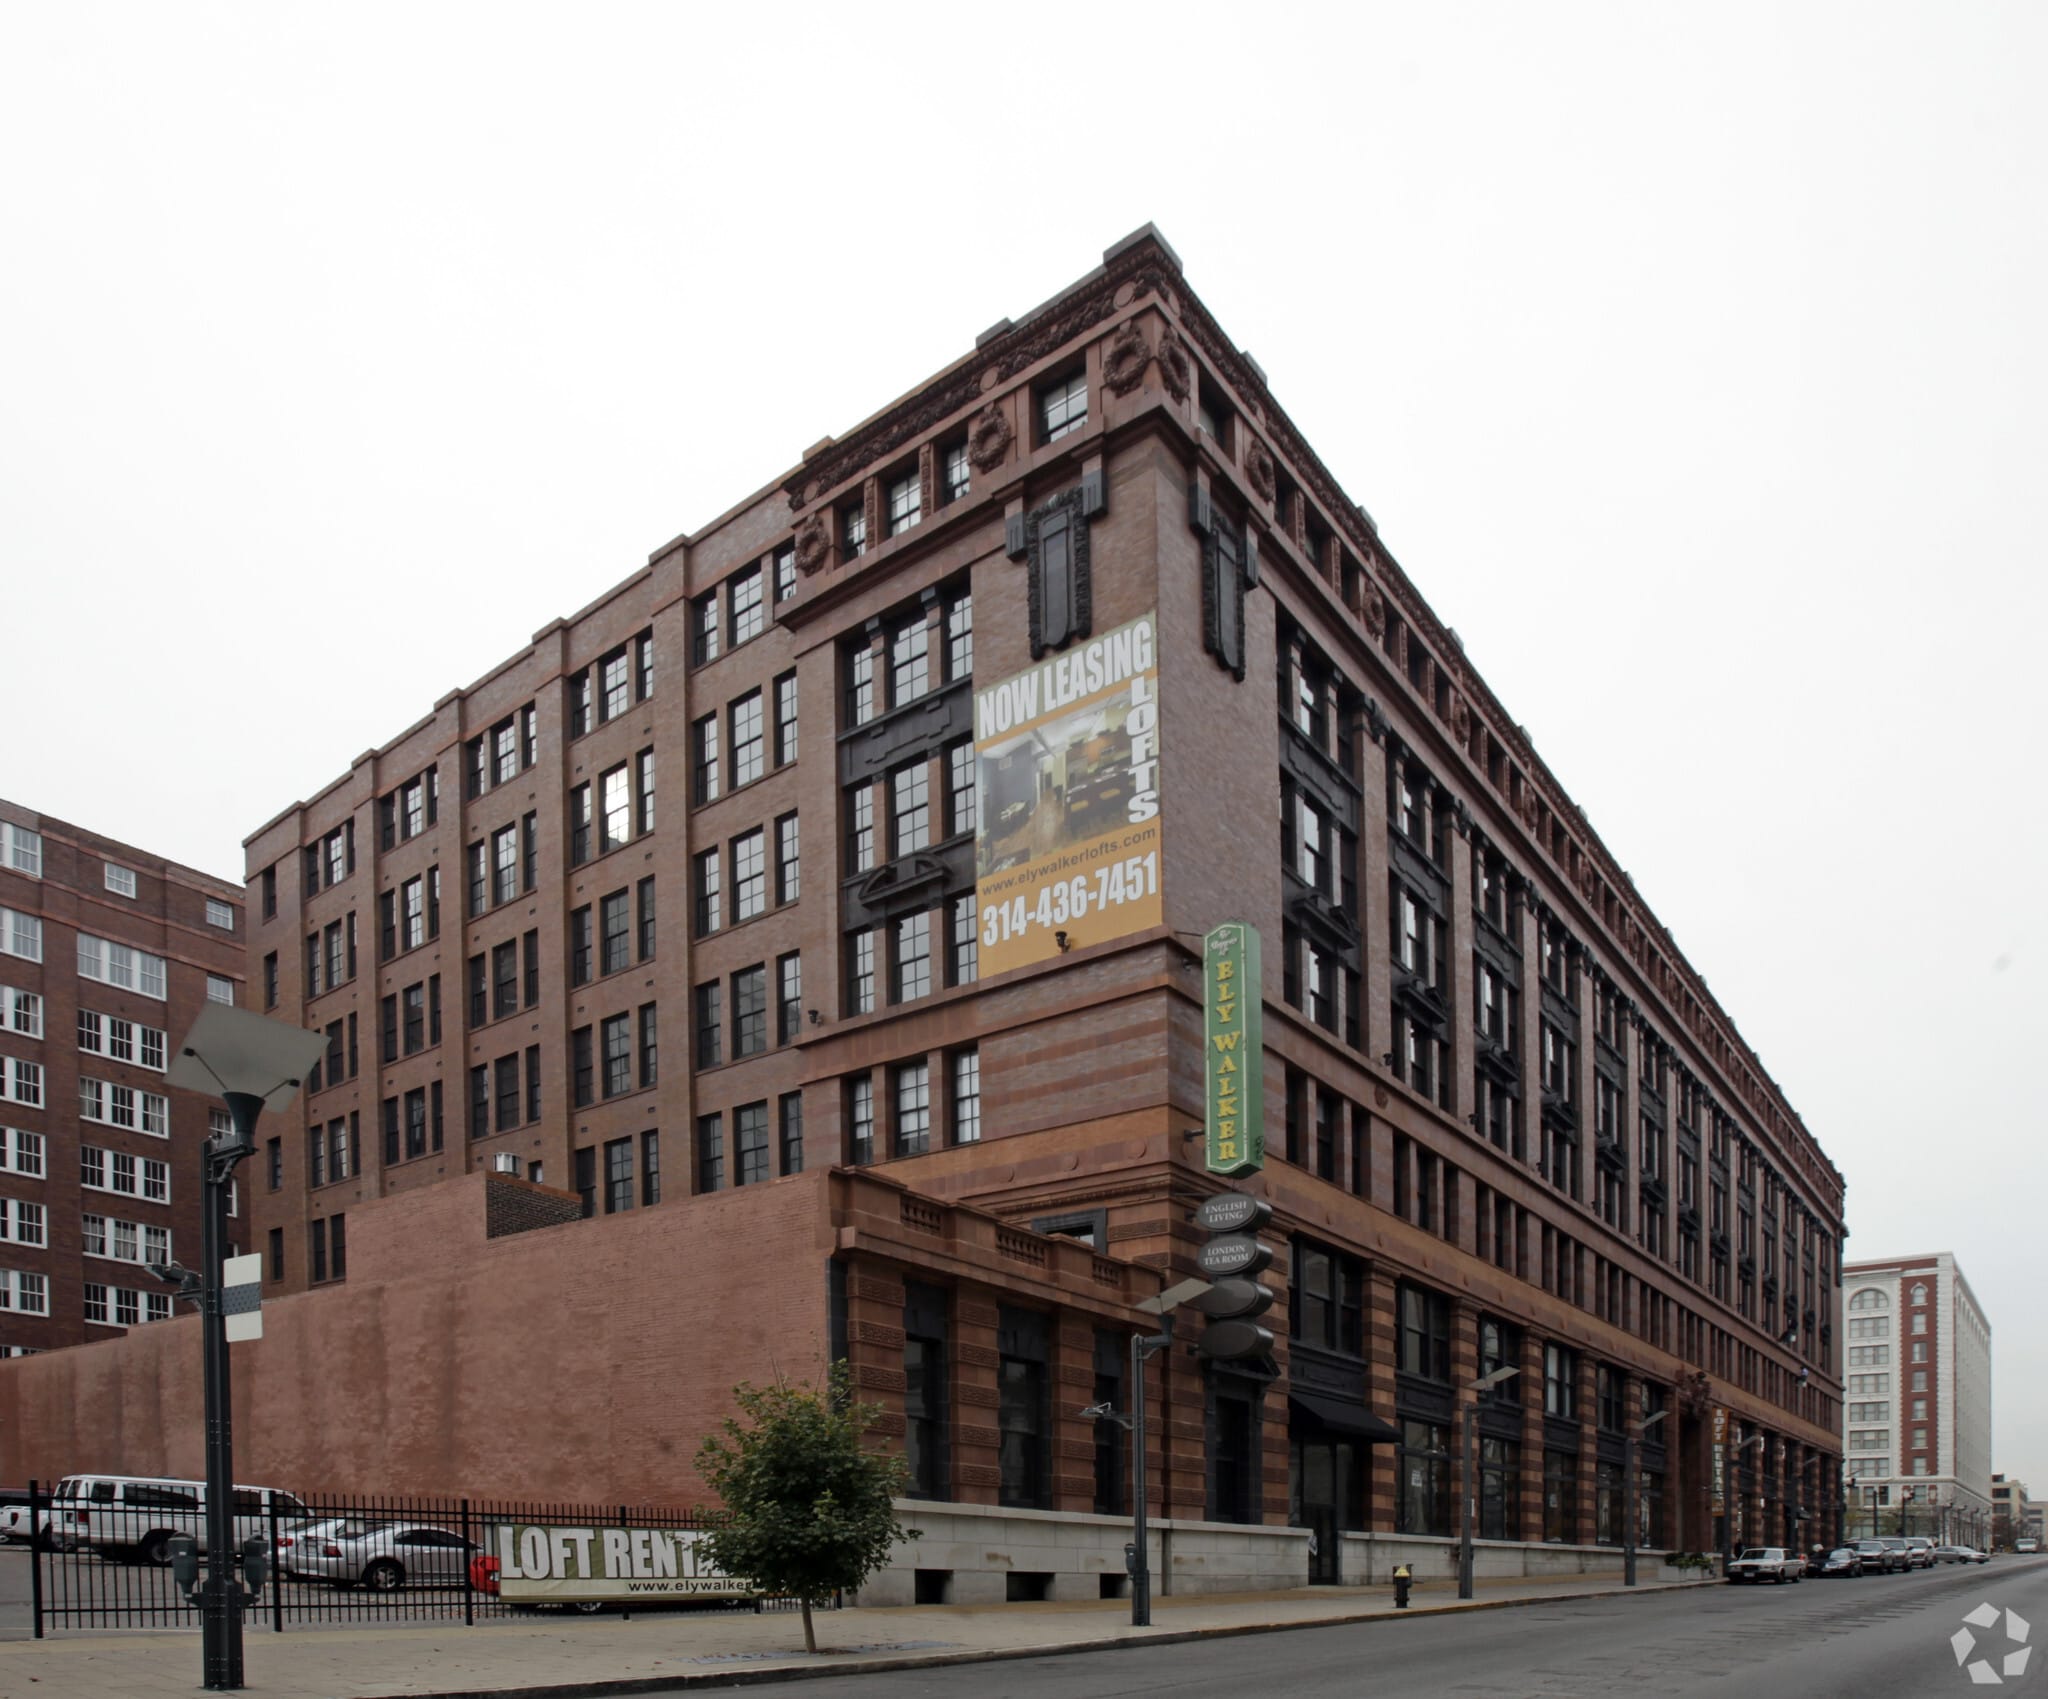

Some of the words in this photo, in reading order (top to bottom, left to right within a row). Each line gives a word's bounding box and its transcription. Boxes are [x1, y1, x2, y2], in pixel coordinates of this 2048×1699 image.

[979, 671, 1039, 740] NOW
[1044, 620, 1153, 712] LEASING
[1126, 677, 1159, 824] LOFTS
[982, 828, 1156, 895] www.elywalkerlofts.com
[983, 851, 1157, 947] 314-436-7451
[1216, 960, 1235, 1024] ELY
[1212, 1031, 1240, 1161] WALKER
[1205, 1201, 1247, 1214] ENGLISH
[1209, 1211, 1243, 1223] LIVING
[1204, 1256, 1220, 1266] TEA
[1222, 1253, 1249, 1264] ROOM
[1207, 1244, 1246, 1257] LONDON
[499, 1526, 596, 1580] LOFT
[602, 1528, 734, 1579] RENTA
[628, 1580, 753, 1594] www.elywalker
